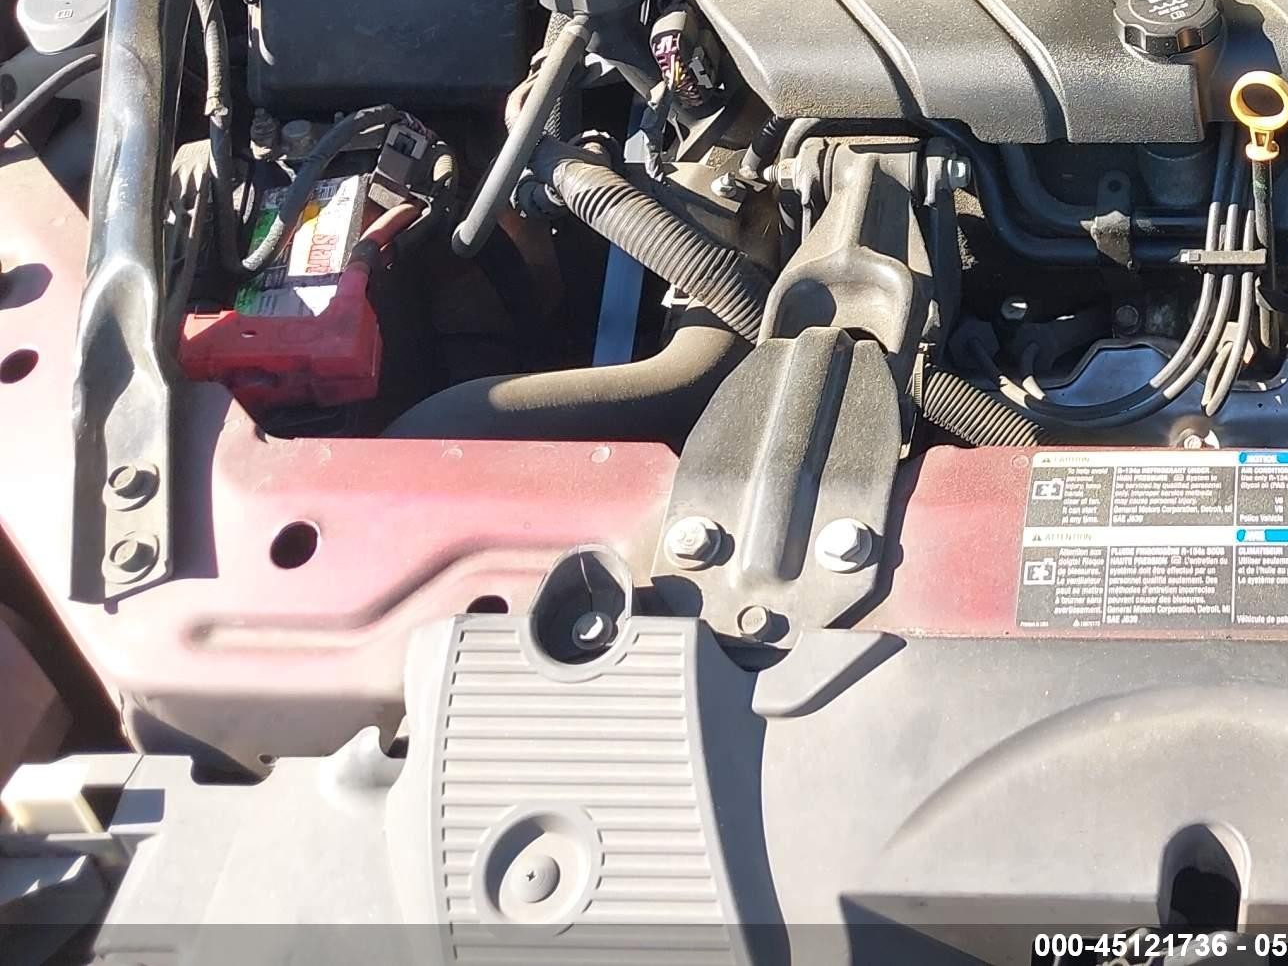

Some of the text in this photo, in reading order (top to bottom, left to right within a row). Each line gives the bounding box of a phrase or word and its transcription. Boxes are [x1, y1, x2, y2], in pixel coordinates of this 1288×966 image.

[1254, 475, 1268, 483] only
[1239, 514, 1260, 523] Police
[1245, 566, 1255, 574] de
[1238, 576, 1247, 584] Le
[1159, 596, 1171, 604] des
[1107, 605, 1132, 614] General
[1132, 605, 1156, 613] Motors
[1106, 615, 1121, 624] SAE
[1265, 615, 1276, 623] de
